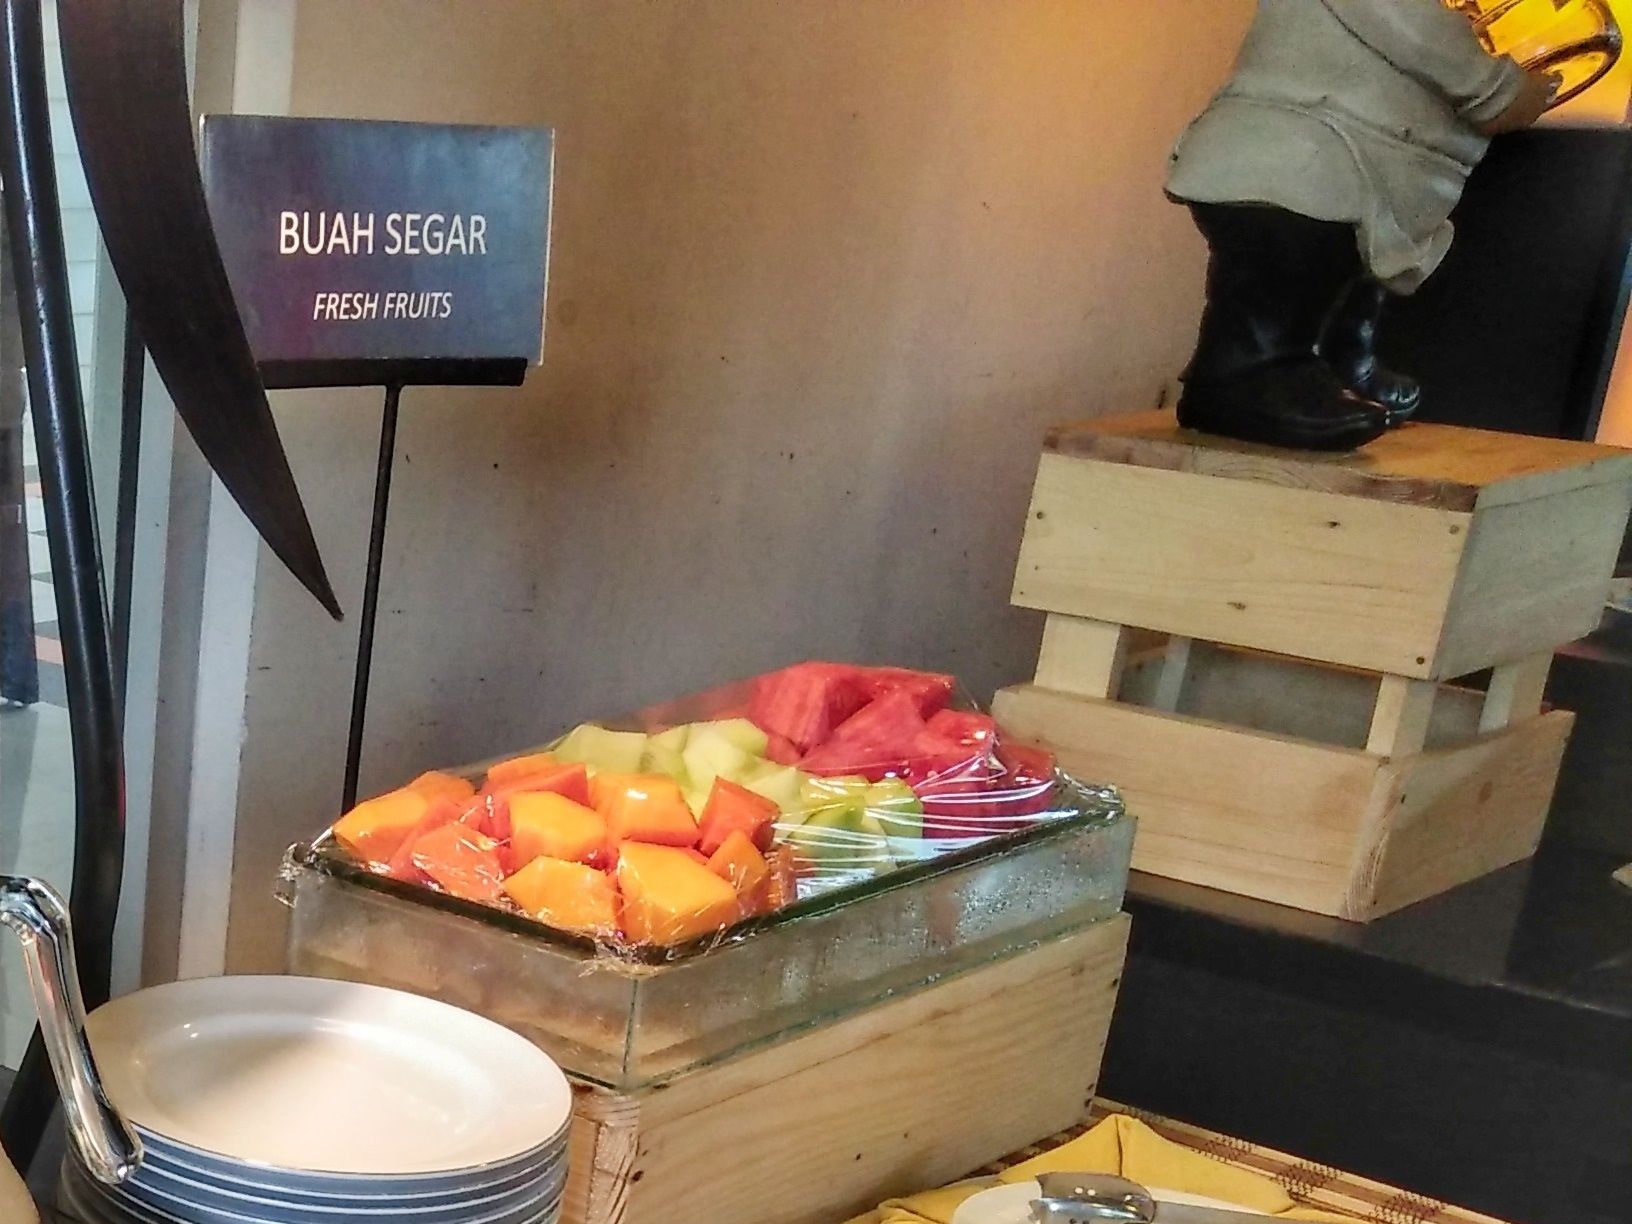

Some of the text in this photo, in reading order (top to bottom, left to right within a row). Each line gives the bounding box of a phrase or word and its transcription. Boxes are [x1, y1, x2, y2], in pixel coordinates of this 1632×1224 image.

[279, 210, 487, 256] BUAH SEGAR
[313, 291, 453, 321] FRESH FRUITS
